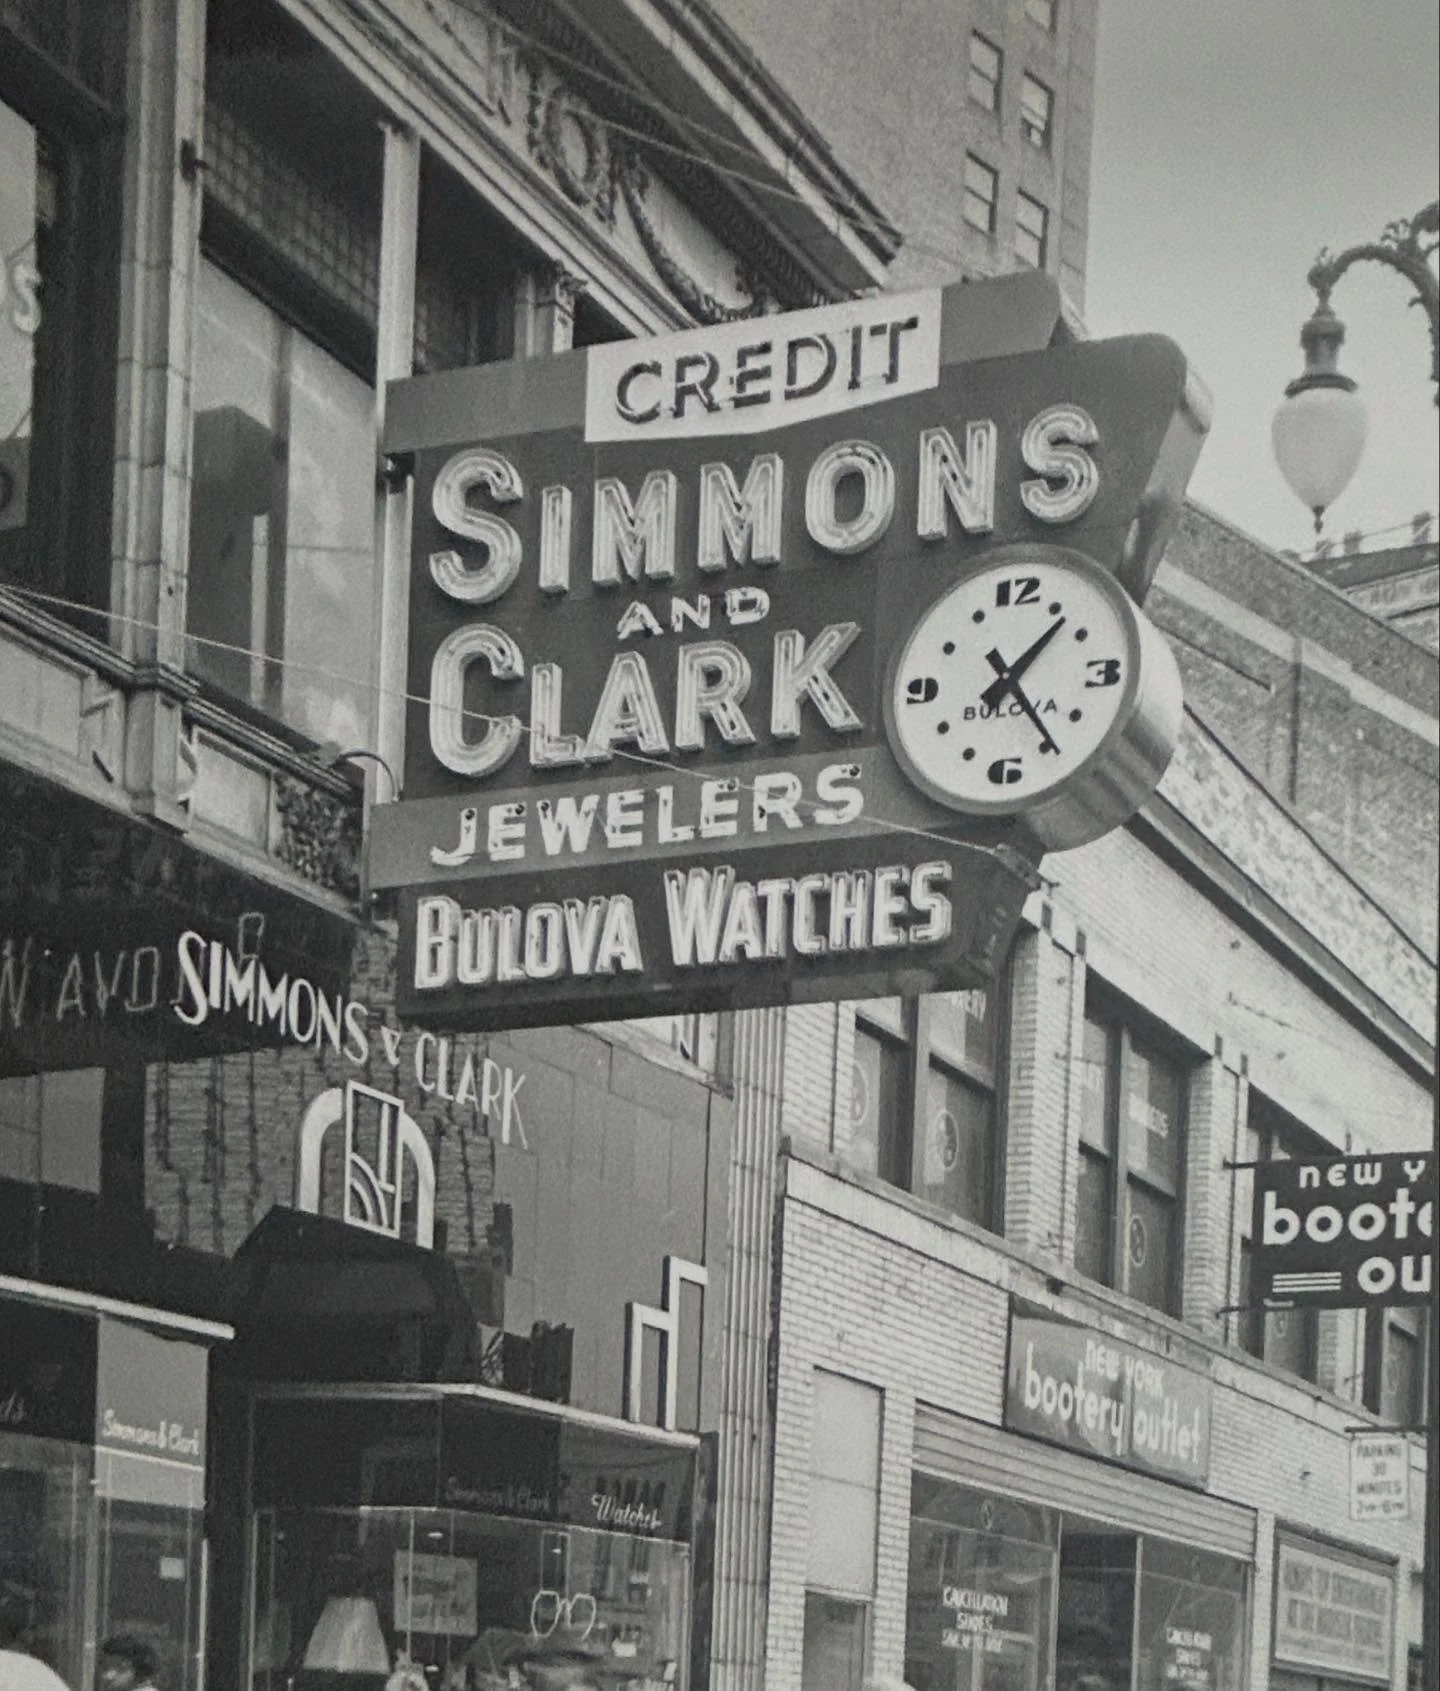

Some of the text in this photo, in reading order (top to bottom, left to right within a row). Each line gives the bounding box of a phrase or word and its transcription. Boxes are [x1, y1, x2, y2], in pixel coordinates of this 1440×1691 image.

[615, 314, 919, 425] CREDIT
[429, 403, 1101, 603] SIMMONS
[617, 586, 771, 641] AND
[995, 576, 1041, 608] 12
[429, 620, 865, 779] CLARK
[906, 676, 939, 706] 9
[1084, 657, 1121, 689] 3
[430, 762, 865, 867] JEWELERS
[987, 756, 1023, 786] 6
[414, 860, 953, 990] BULOVA WATCHES
[173, 929, 369, 1066] SIMMONS
[414, 1031, 529, 1150] CLARK
[1024, 1340, 1201, 1466] bootery outlet
